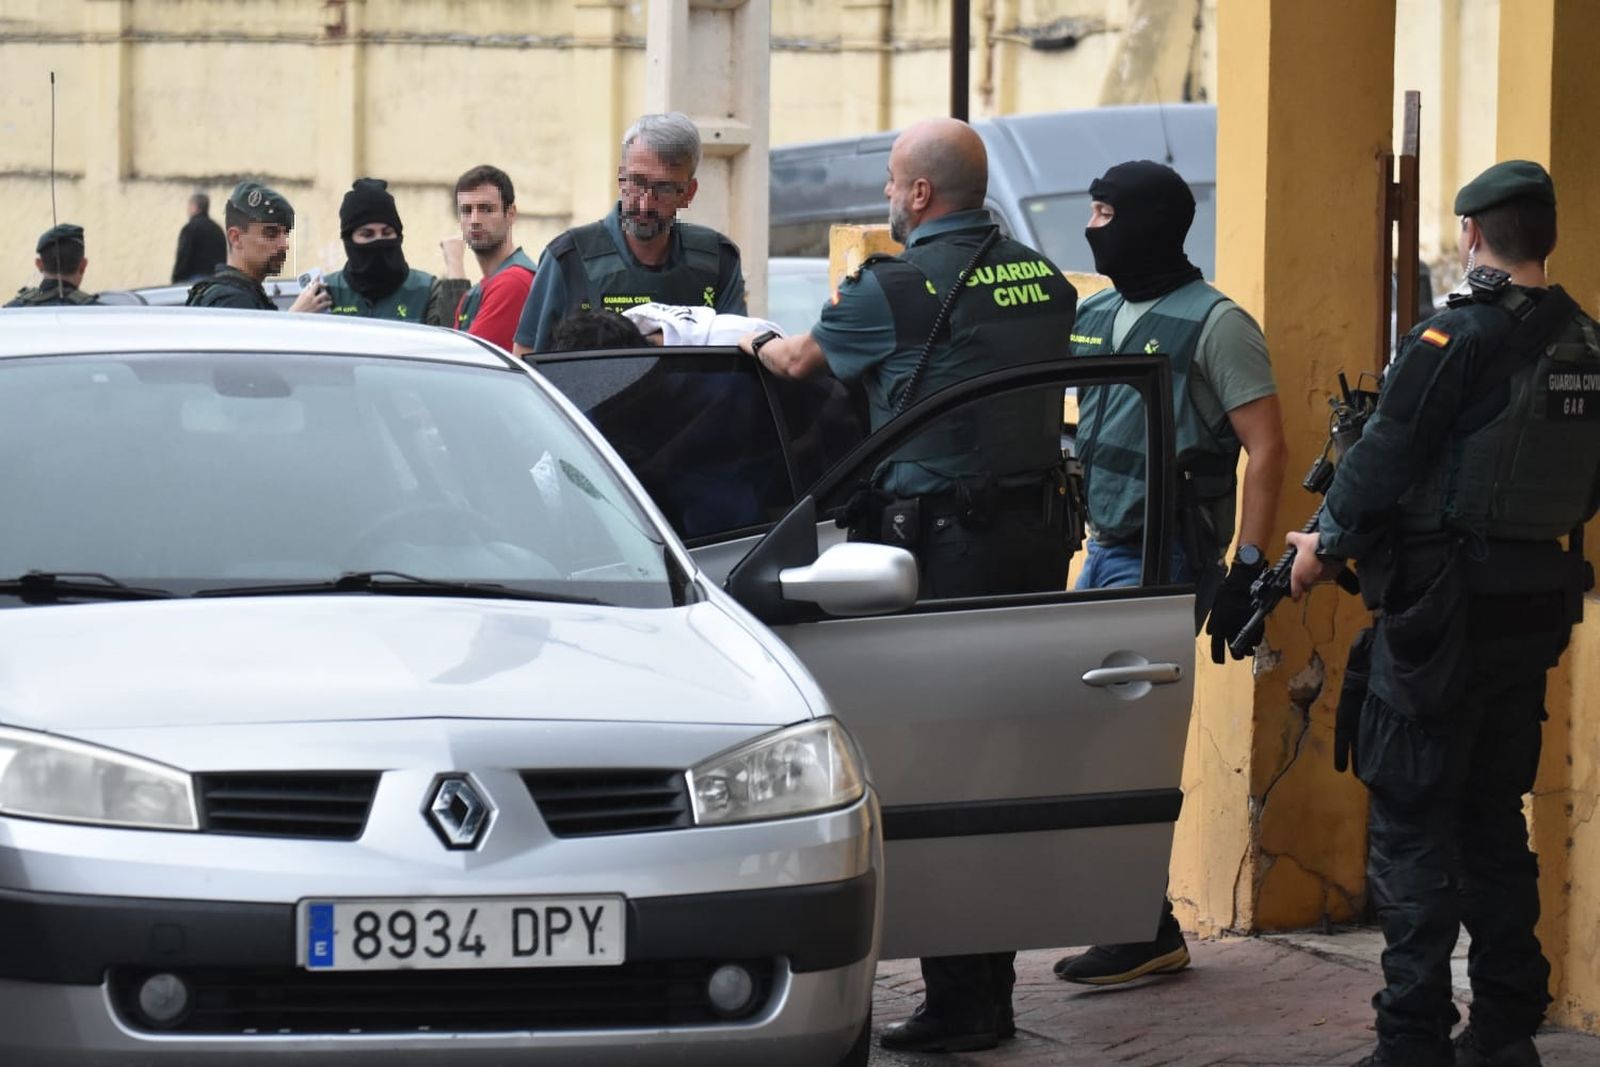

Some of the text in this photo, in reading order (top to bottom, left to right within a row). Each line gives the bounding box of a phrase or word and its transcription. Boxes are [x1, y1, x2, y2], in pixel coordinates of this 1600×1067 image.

[959, 260, 1054, 287] GUARDIA
[993, 283, 1049, 307] CIVIL
[1548, 374, 1582, 391] GUARDIA
[352, 906, 605, 960] 8934 DPY
[314, 941, 327, 956] E
